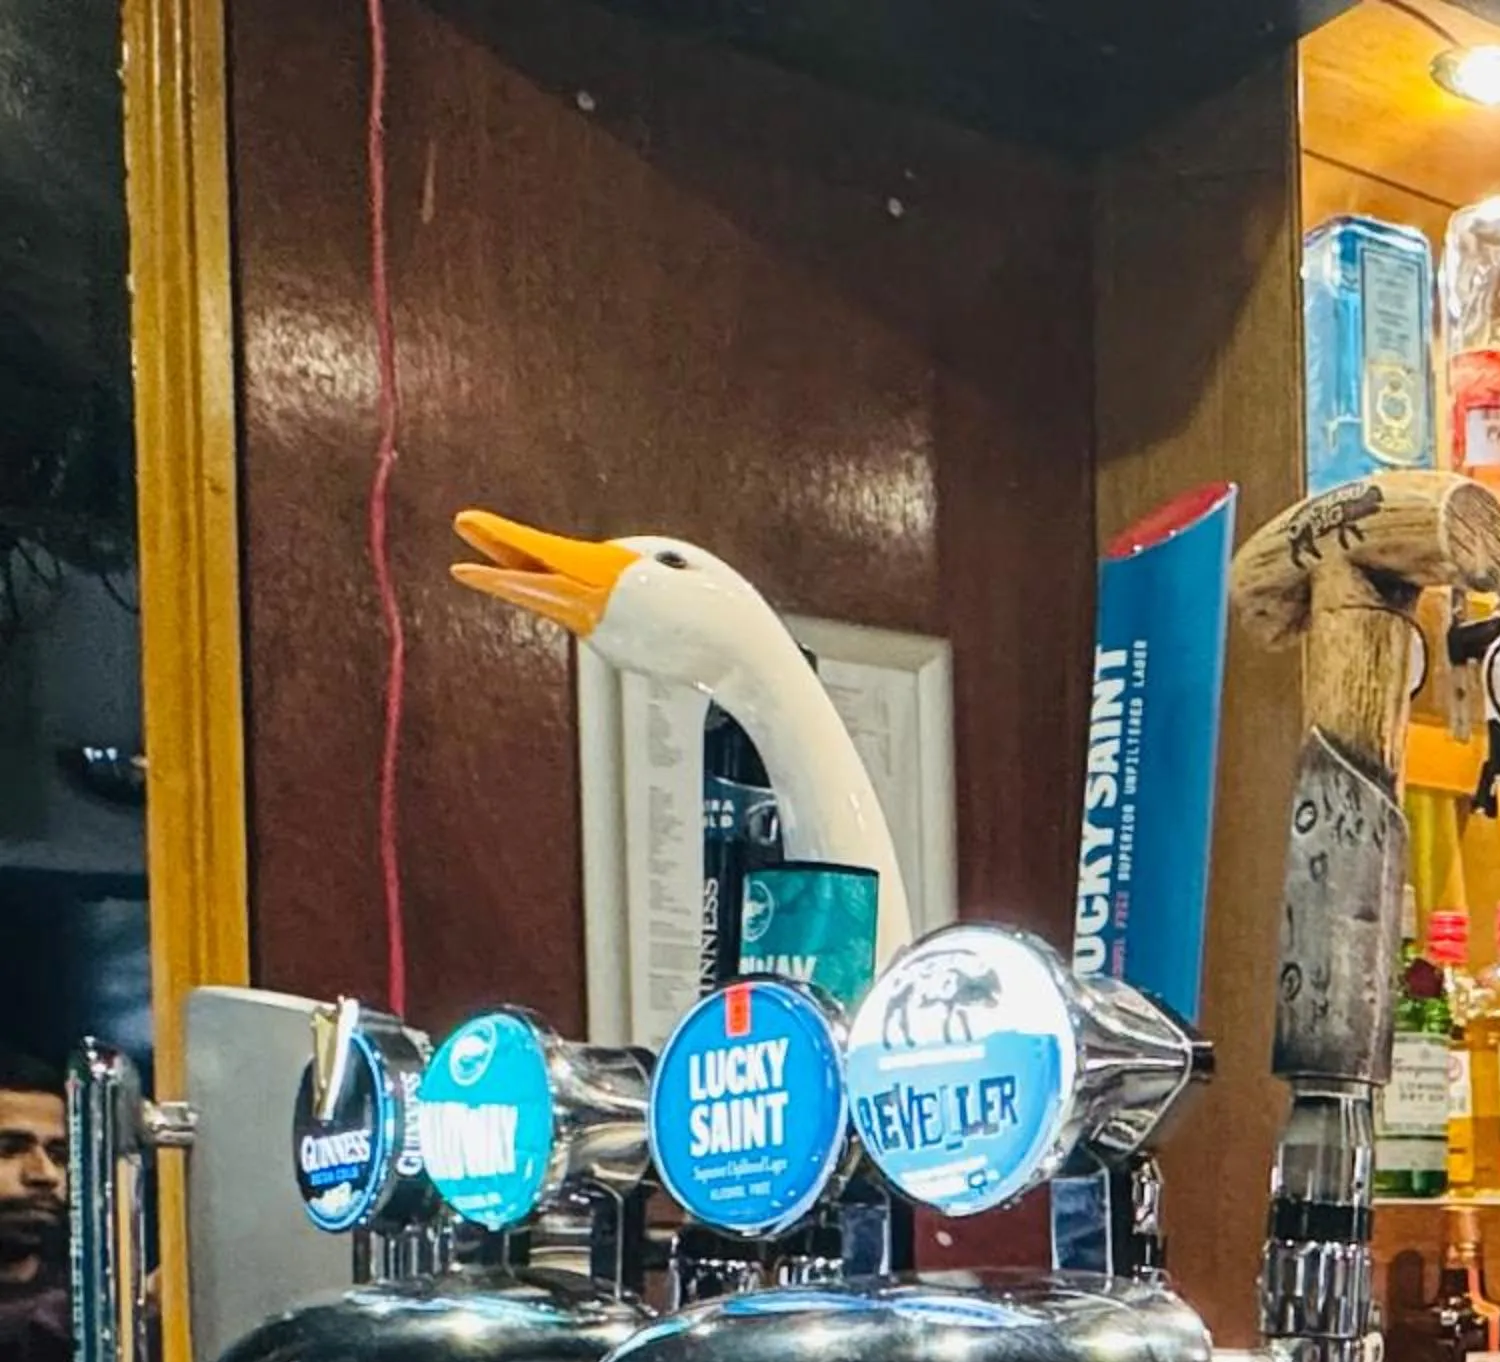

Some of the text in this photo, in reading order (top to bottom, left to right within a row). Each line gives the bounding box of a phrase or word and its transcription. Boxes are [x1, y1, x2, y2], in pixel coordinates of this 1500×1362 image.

[1133, 638, 1149, 688] LAGER
[1124, 696, 1144, 795] UNFILTERED
[1074, 642, 1127, 979] UCKY SAINT
[1118, 803, 1136, 882] SUPERIOR
[689, 1037, 789, 1101] LUCKY
[301, 1129, 371, 1174] GUINNESS
[689, 1093, 788, 1158] SAINT
